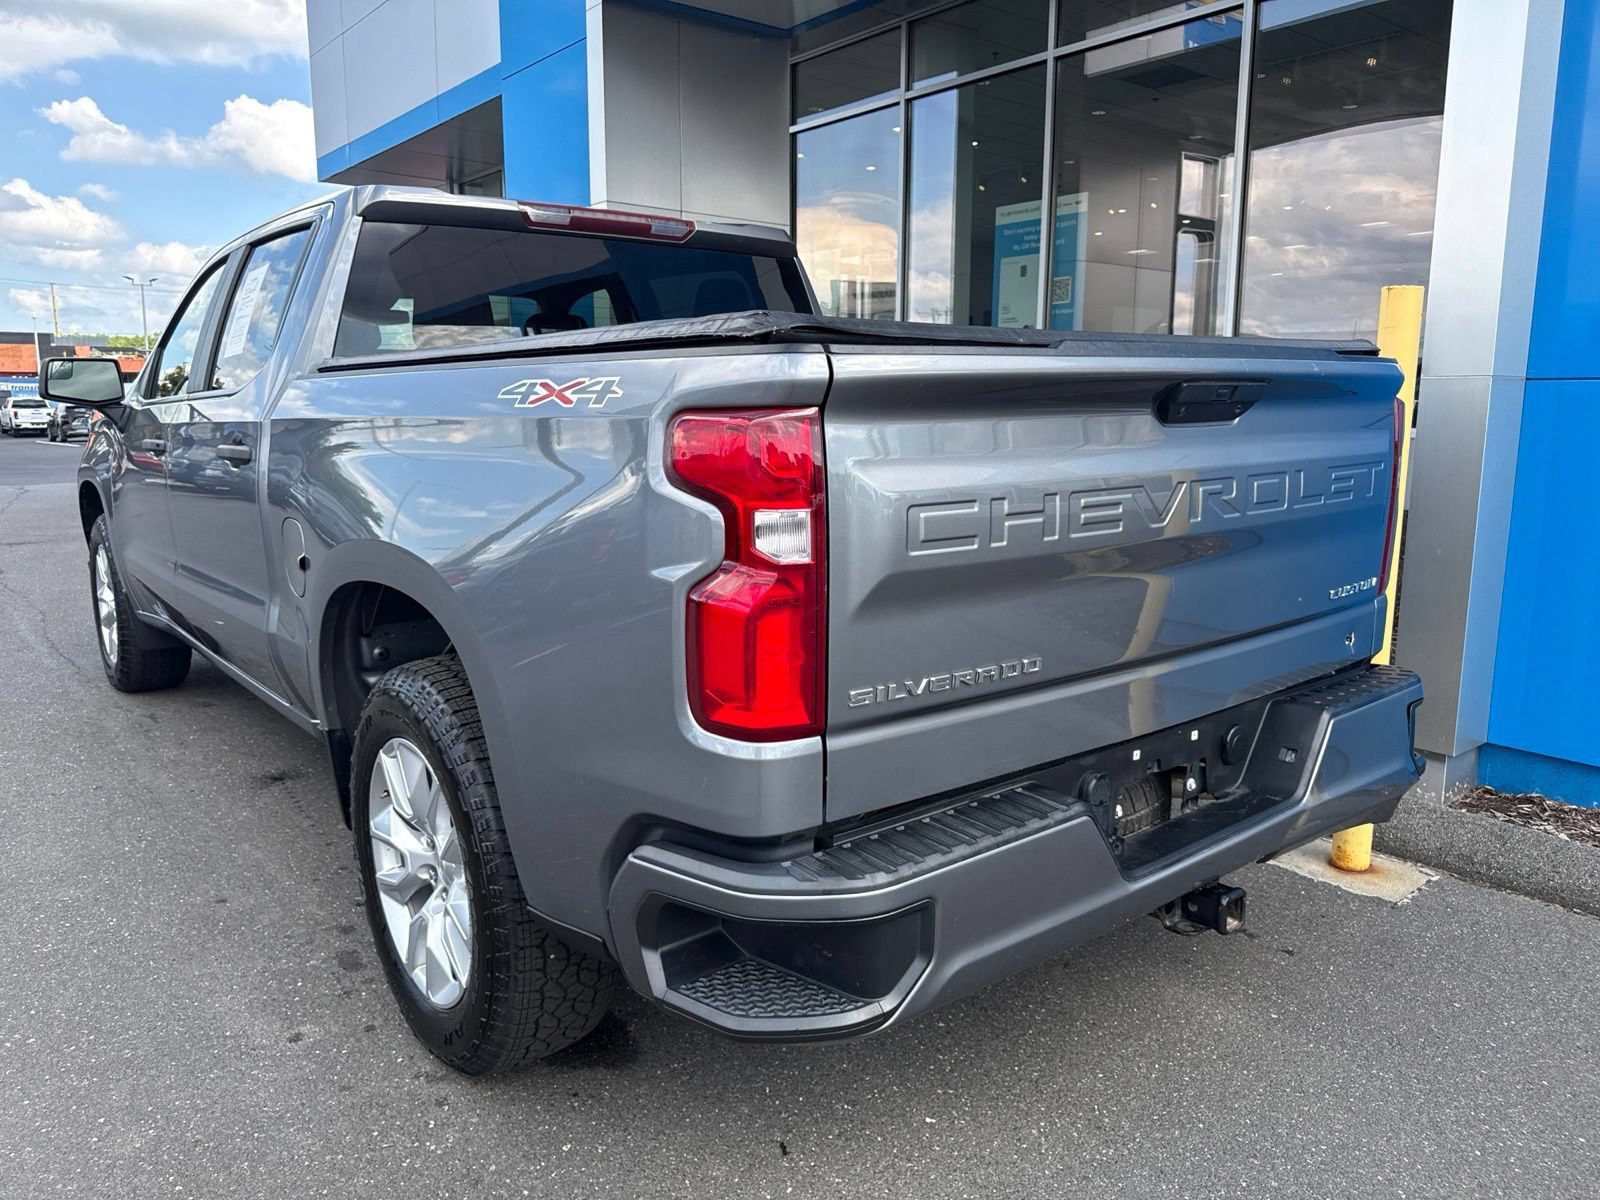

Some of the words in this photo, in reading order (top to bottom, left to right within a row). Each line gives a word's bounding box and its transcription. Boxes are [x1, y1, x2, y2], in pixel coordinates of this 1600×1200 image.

[11, 383, 40, 392] transi
[905, 462, 1385, 557] CHEVROLET
[848, 656, 1043, 707] SILVERADO
